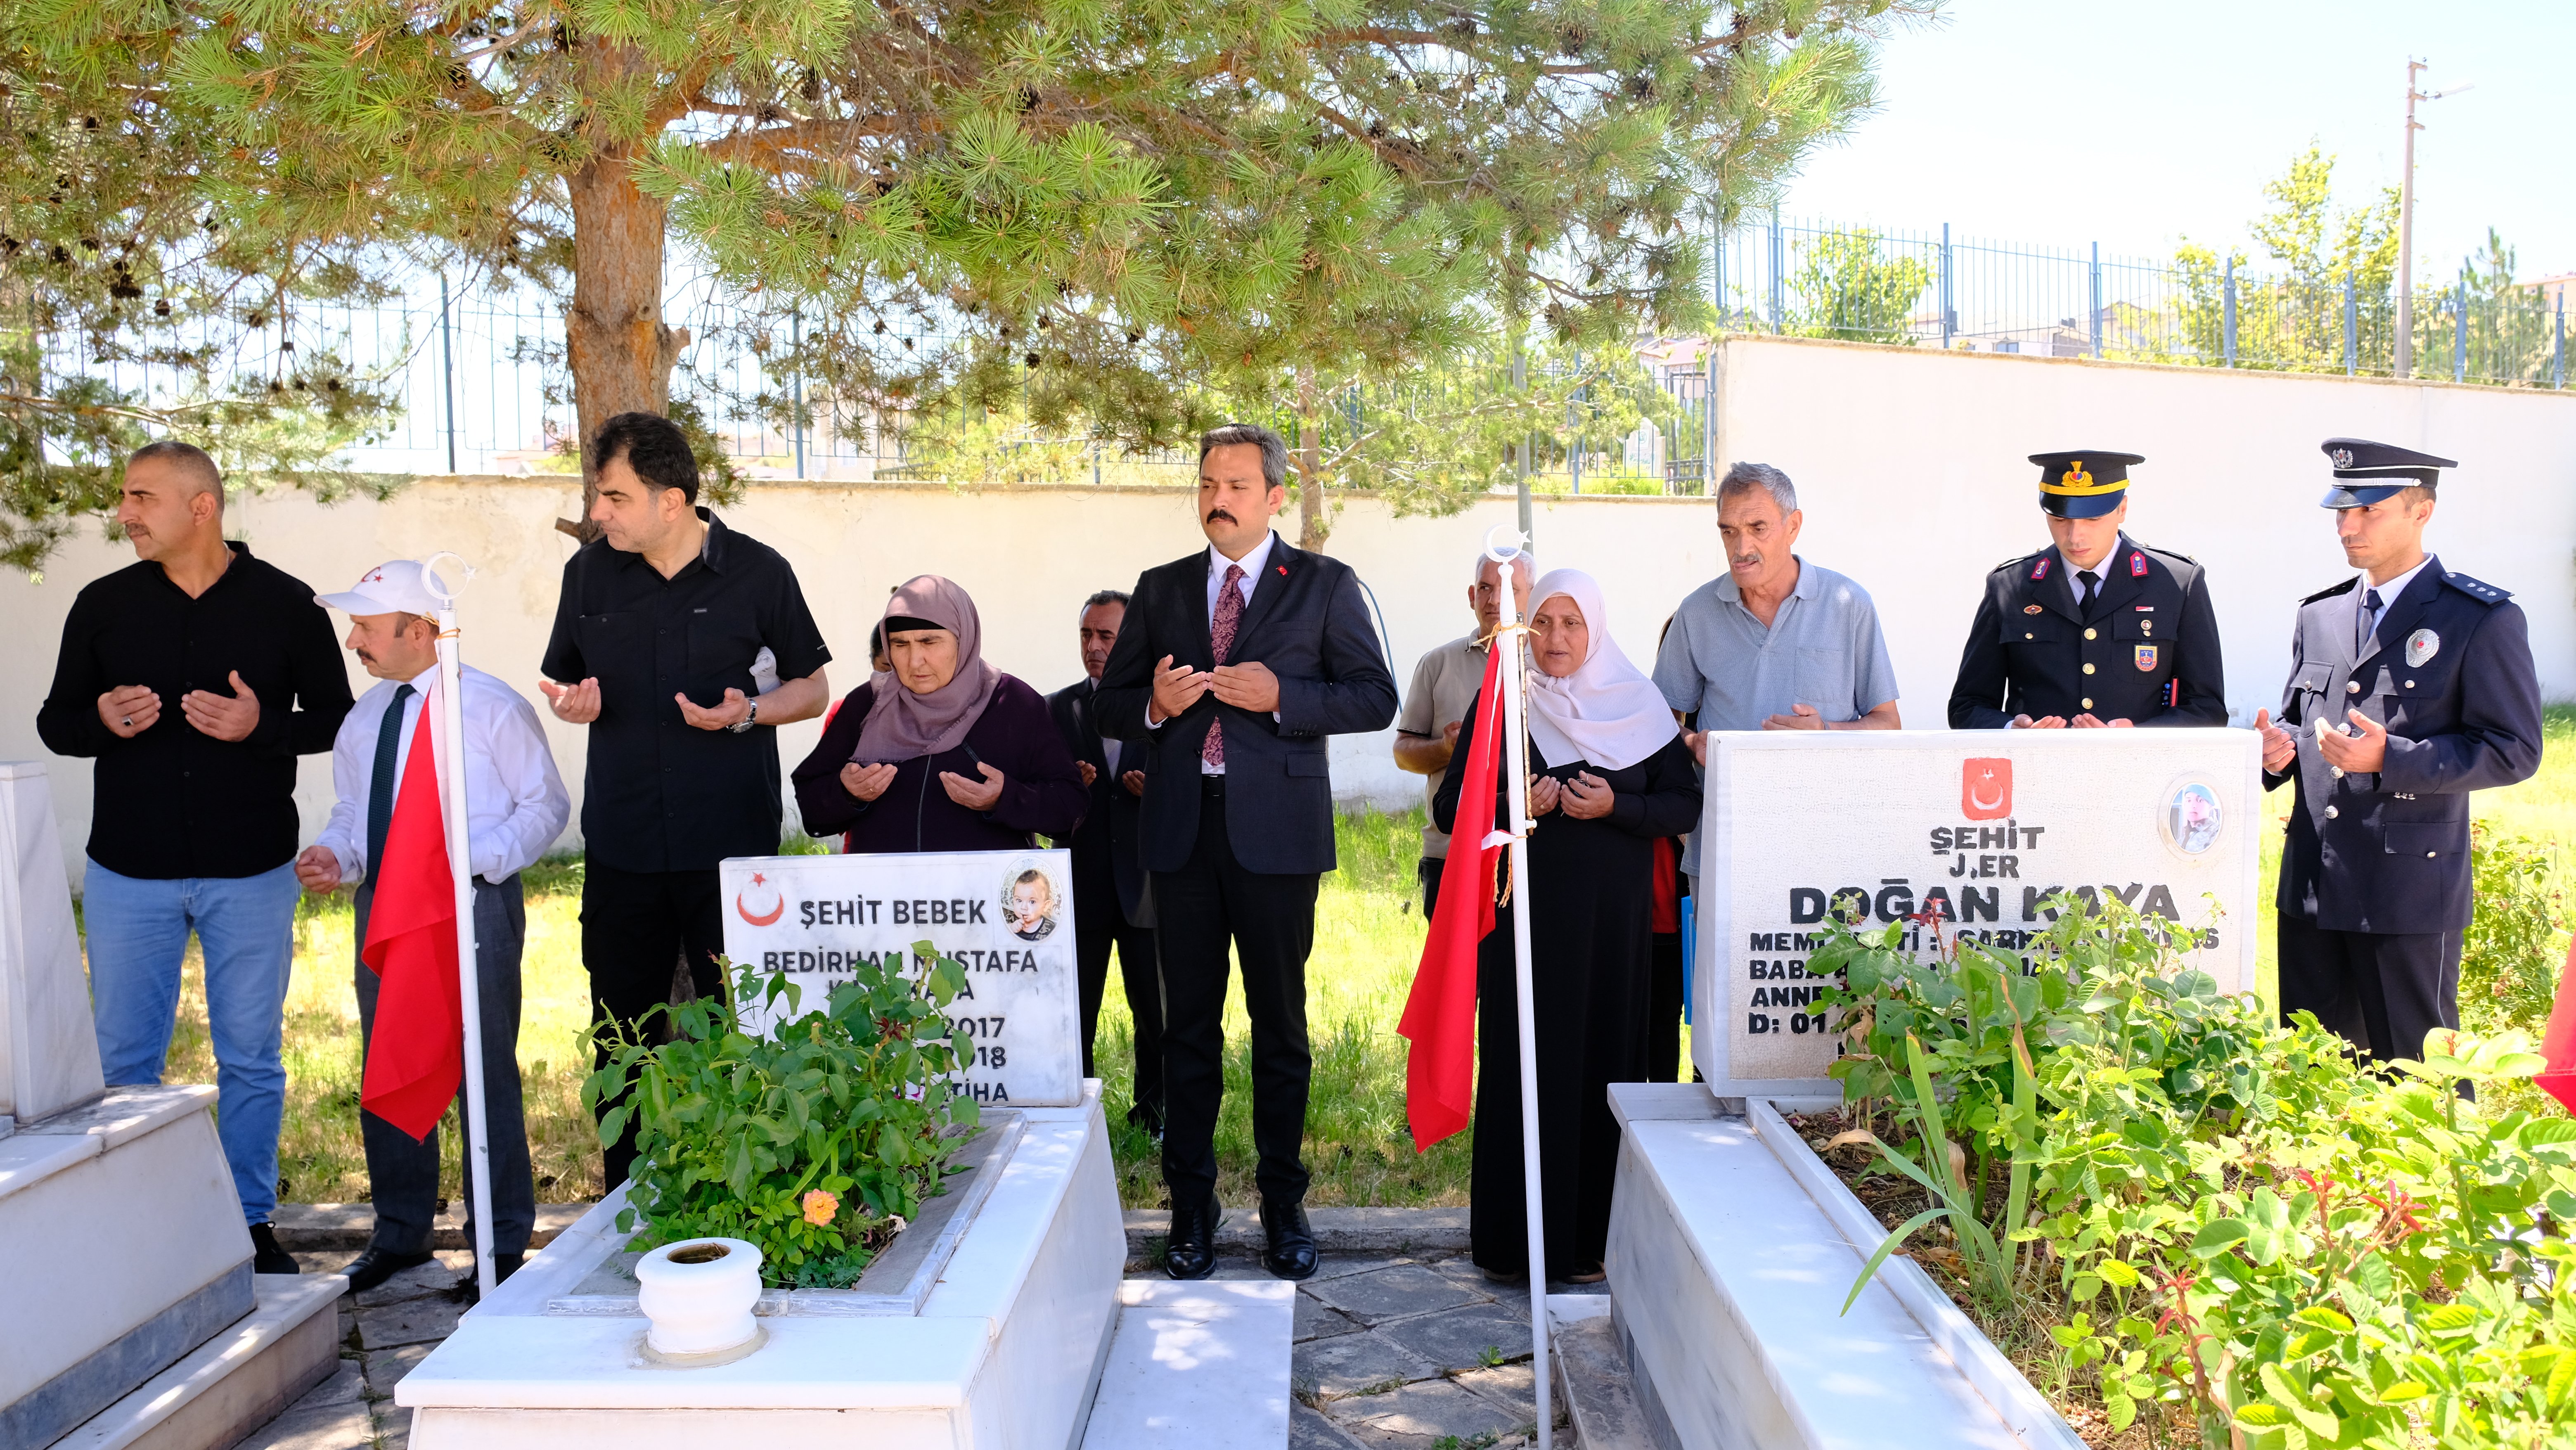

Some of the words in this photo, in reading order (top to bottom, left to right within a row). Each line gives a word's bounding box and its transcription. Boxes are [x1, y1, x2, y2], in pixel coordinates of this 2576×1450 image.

[1930, 817, 2045, 855] ŞEHİT
[800, 894, 882, 929] ŞEHİT
[893, 899, 987, 926] BEBEK
[1790, 878, 1999, 924] DOĞAN
[2022, 882, 2180, 922] KAYA
[1750, 922, 1919, 951] MEMTİ
[1748, 1012, 1779, 1034] D:
[921, 1078, 1009, 1102] TİHA
